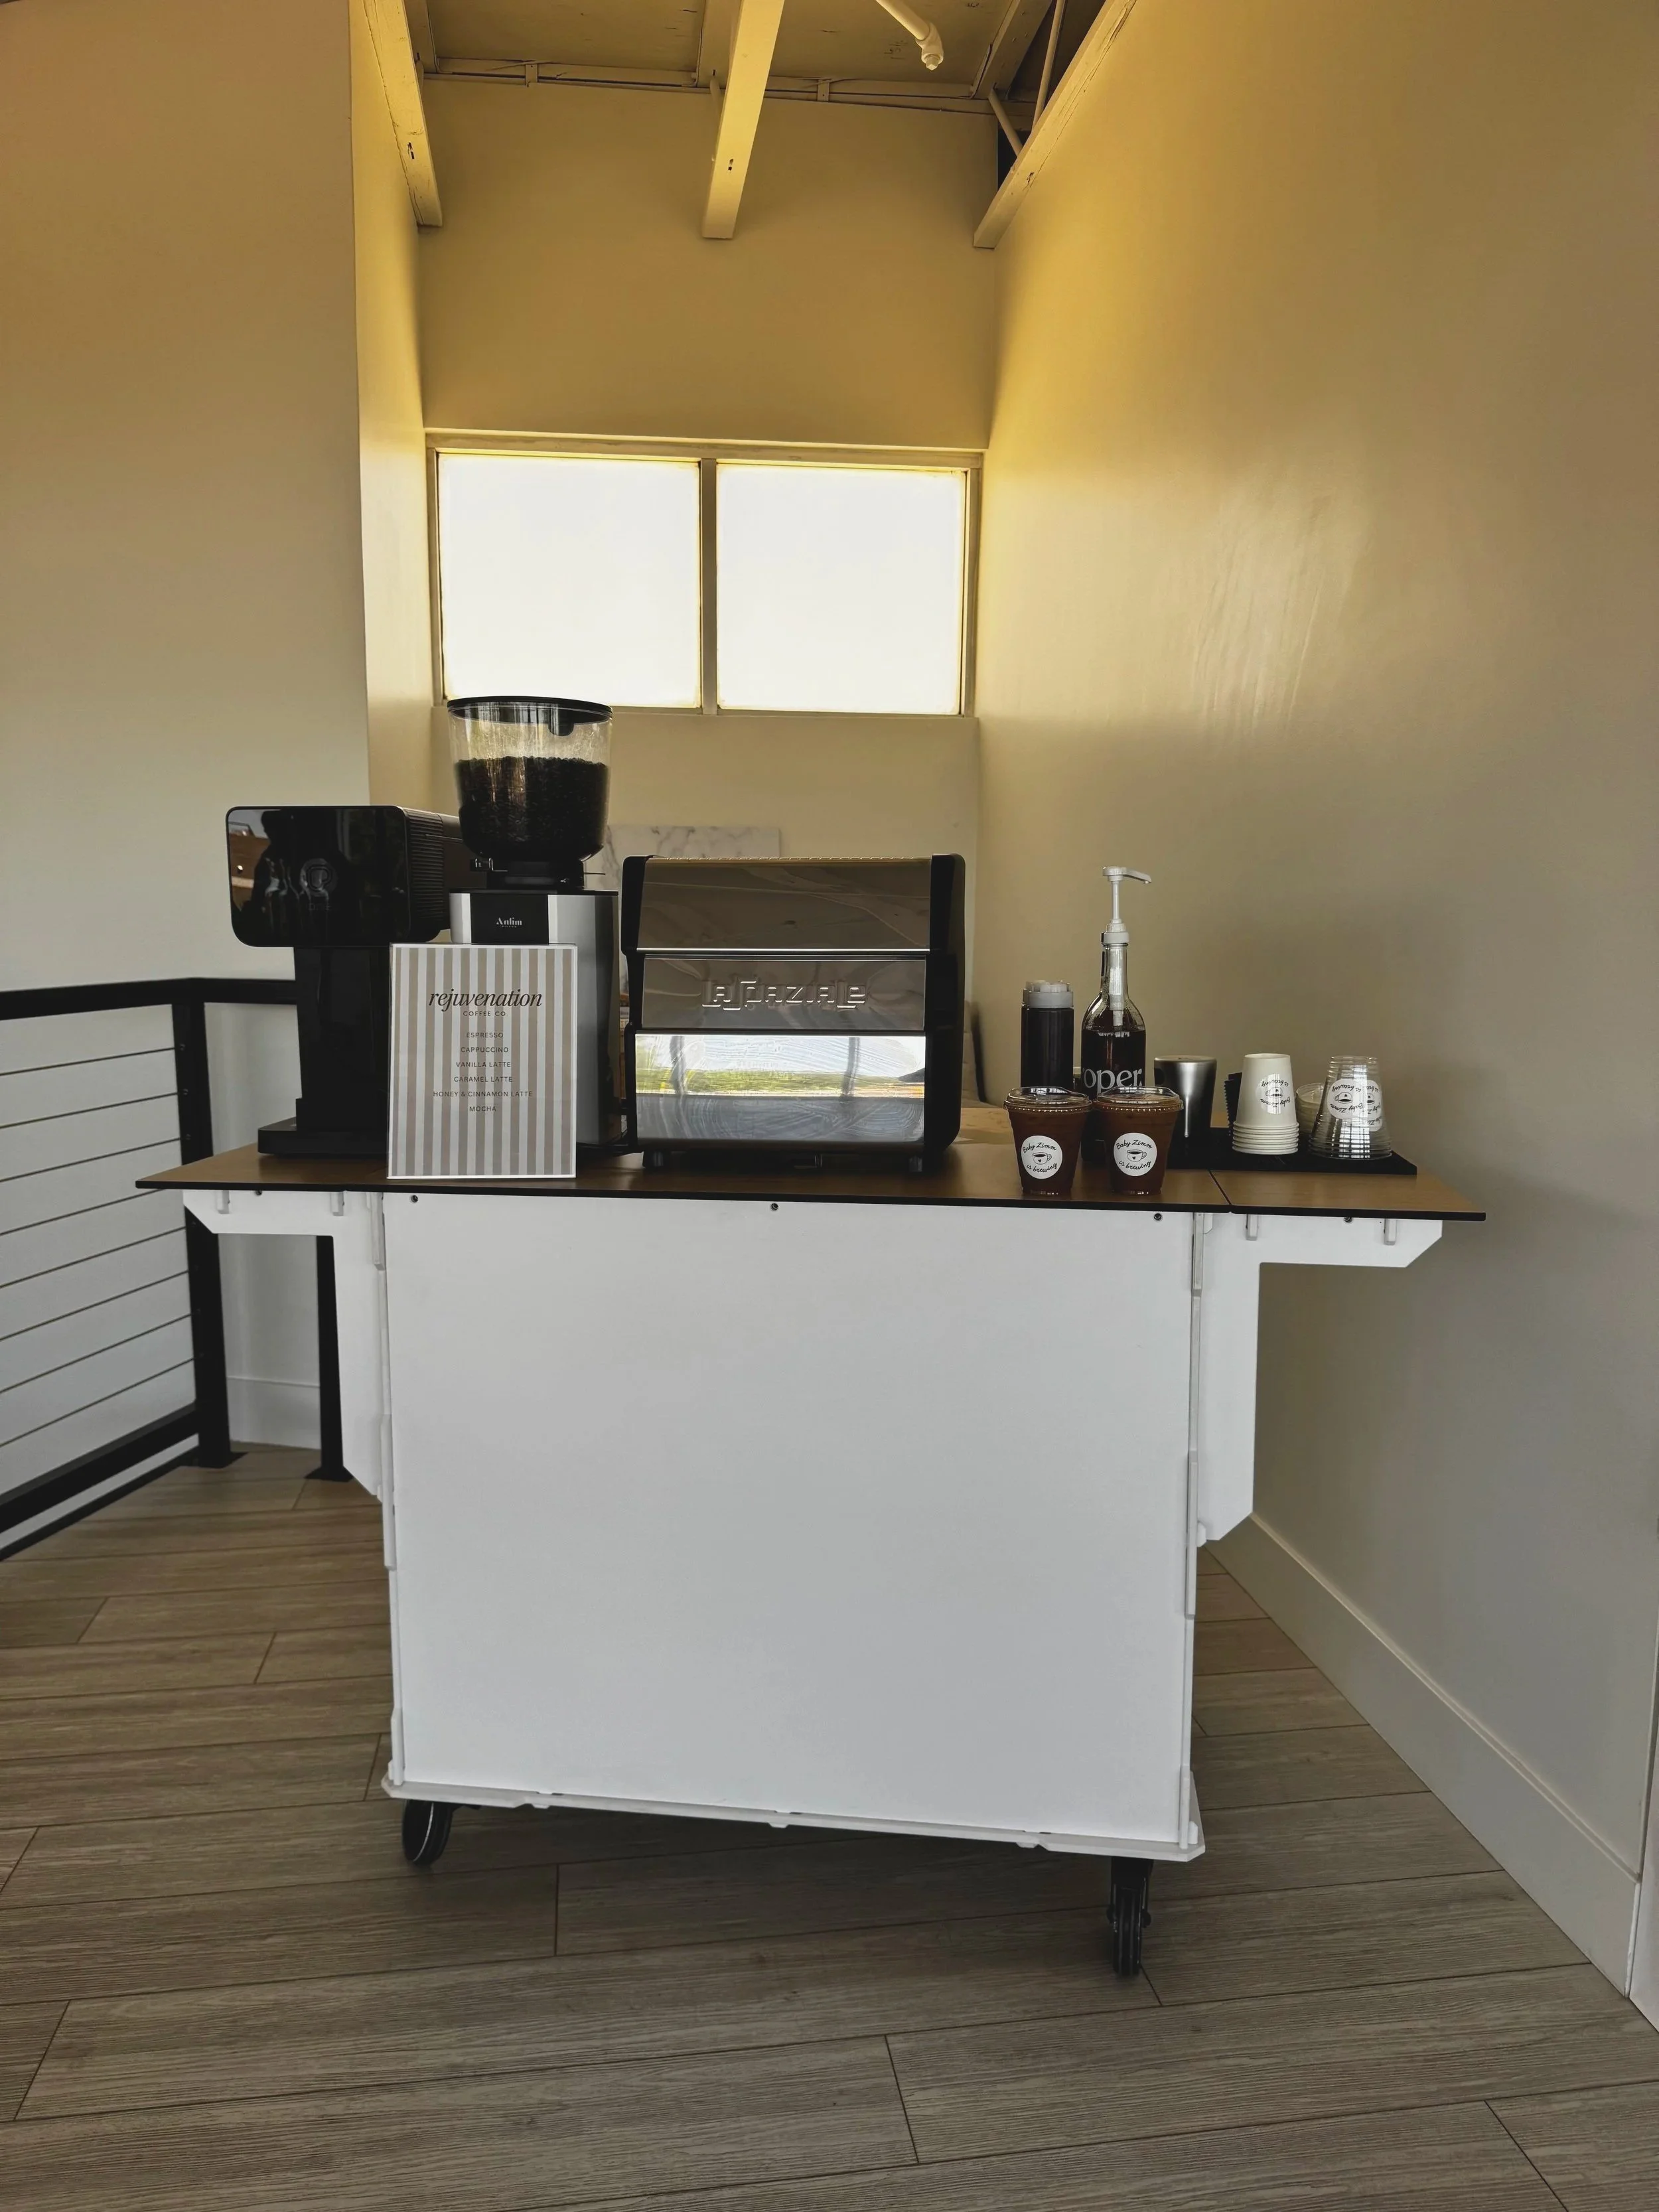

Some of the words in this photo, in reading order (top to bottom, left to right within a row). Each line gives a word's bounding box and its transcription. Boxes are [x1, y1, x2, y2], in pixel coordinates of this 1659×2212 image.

[428, 988, 542, 1012] rejuvenation
[1023, 1143, 1035, 1153] Baby
[1036, 1142, 1057, 1151] Zimm
[1116, 1140, 1131, 1149] Baby
[1132, 1140, 1153, 1149] Zimm
[1033, 1162, 1058, 1173] brewing
[1125, 1161, 1151, 1170] brewing
